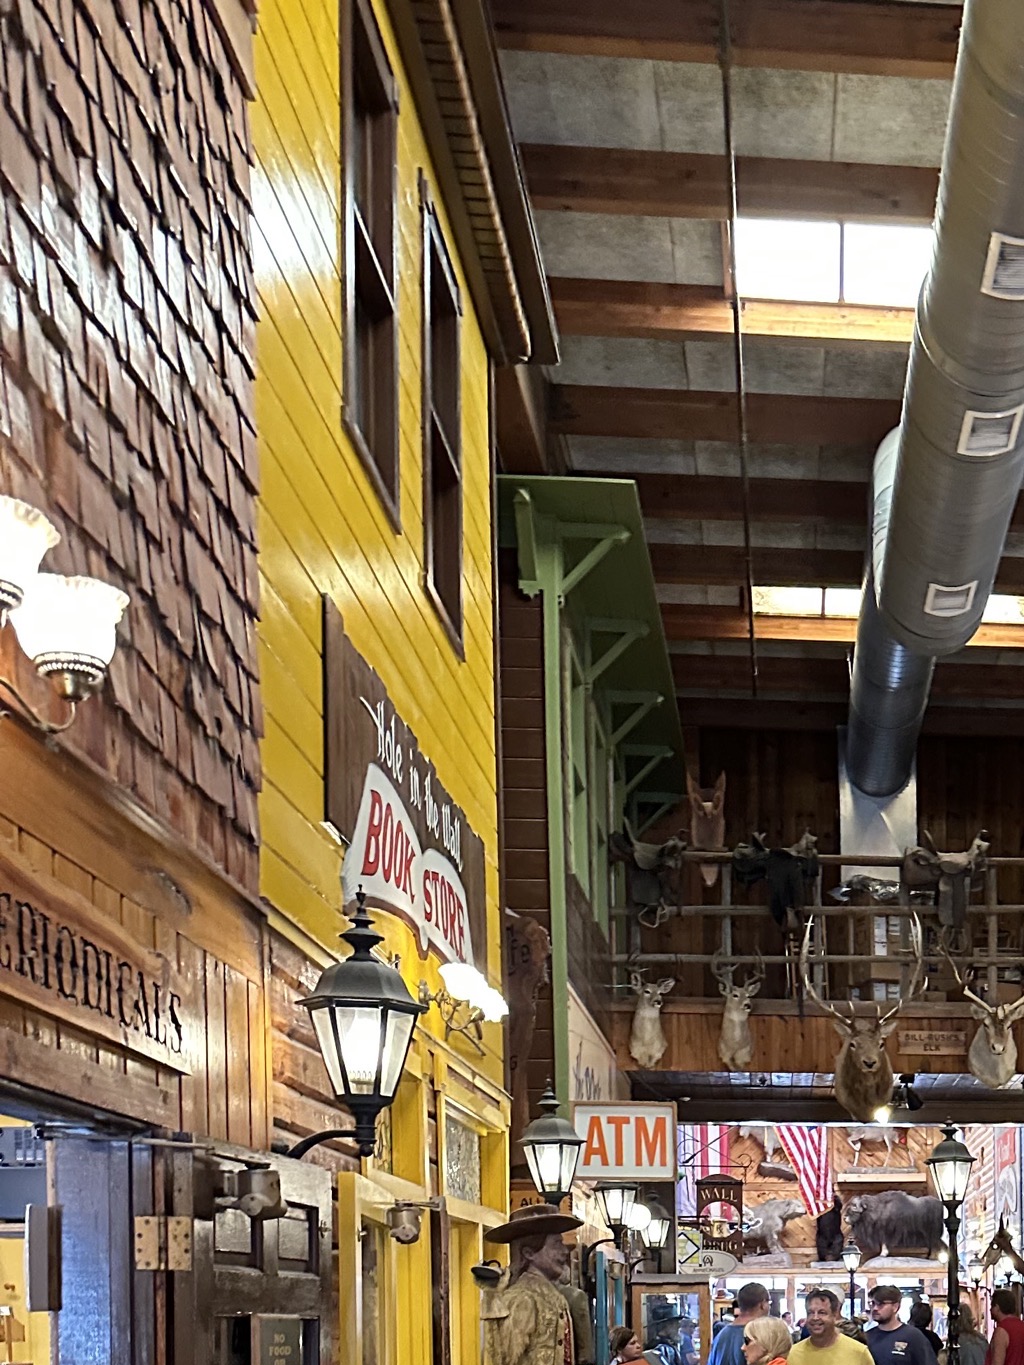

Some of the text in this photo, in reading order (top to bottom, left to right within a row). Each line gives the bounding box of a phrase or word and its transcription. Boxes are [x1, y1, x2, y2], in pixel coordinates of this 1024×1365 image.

[360, 696, 403, 783] Hole
[409, 748, 421, 810] in
[424, 771, 439, 839] the
[361, 789, 464, 962] BOOK STORE
[0, 892, 183, 1053] ERIODICALS
[924, 1043, 941, 1052] ELK
[583, 1116, 667, 1167] ATM
[701, 1188, 737, 1202] WALL
[268, 1346, 292, 1356] FOOD
[274, 1333, 285, 1344] NO
